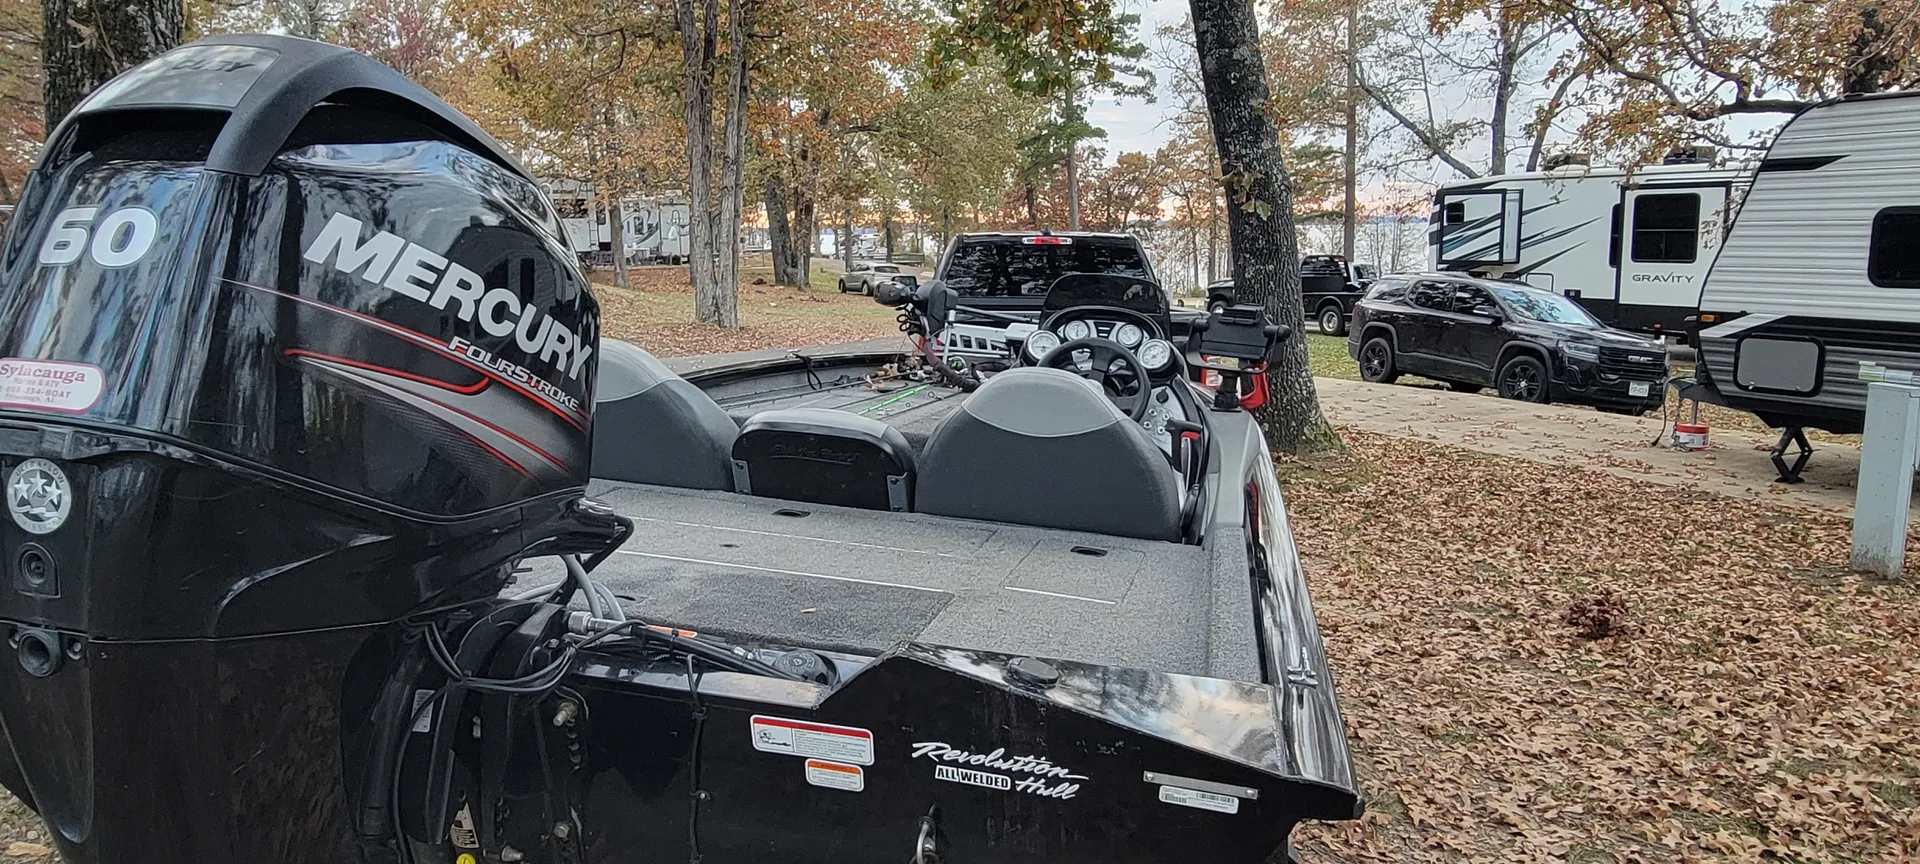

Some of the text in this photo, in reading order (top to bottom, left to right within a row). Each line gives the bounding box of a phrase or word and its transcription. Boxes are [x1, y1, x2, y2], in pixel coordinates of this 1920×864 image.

[38, 205, 159, 269] 60
[1632, 271, 1695, 284] GRAVITY
[303, 211, 594, 381] MERCURY
[0, 363, 86, 384] Sylacauga
[447, 335, 580, 412] FOURSTROKE
[912, 742, 1089, 780] Revolution
[937, 768, 1009, 789] ALL WELDED
[1015, 776, 1080, 800] Hull
